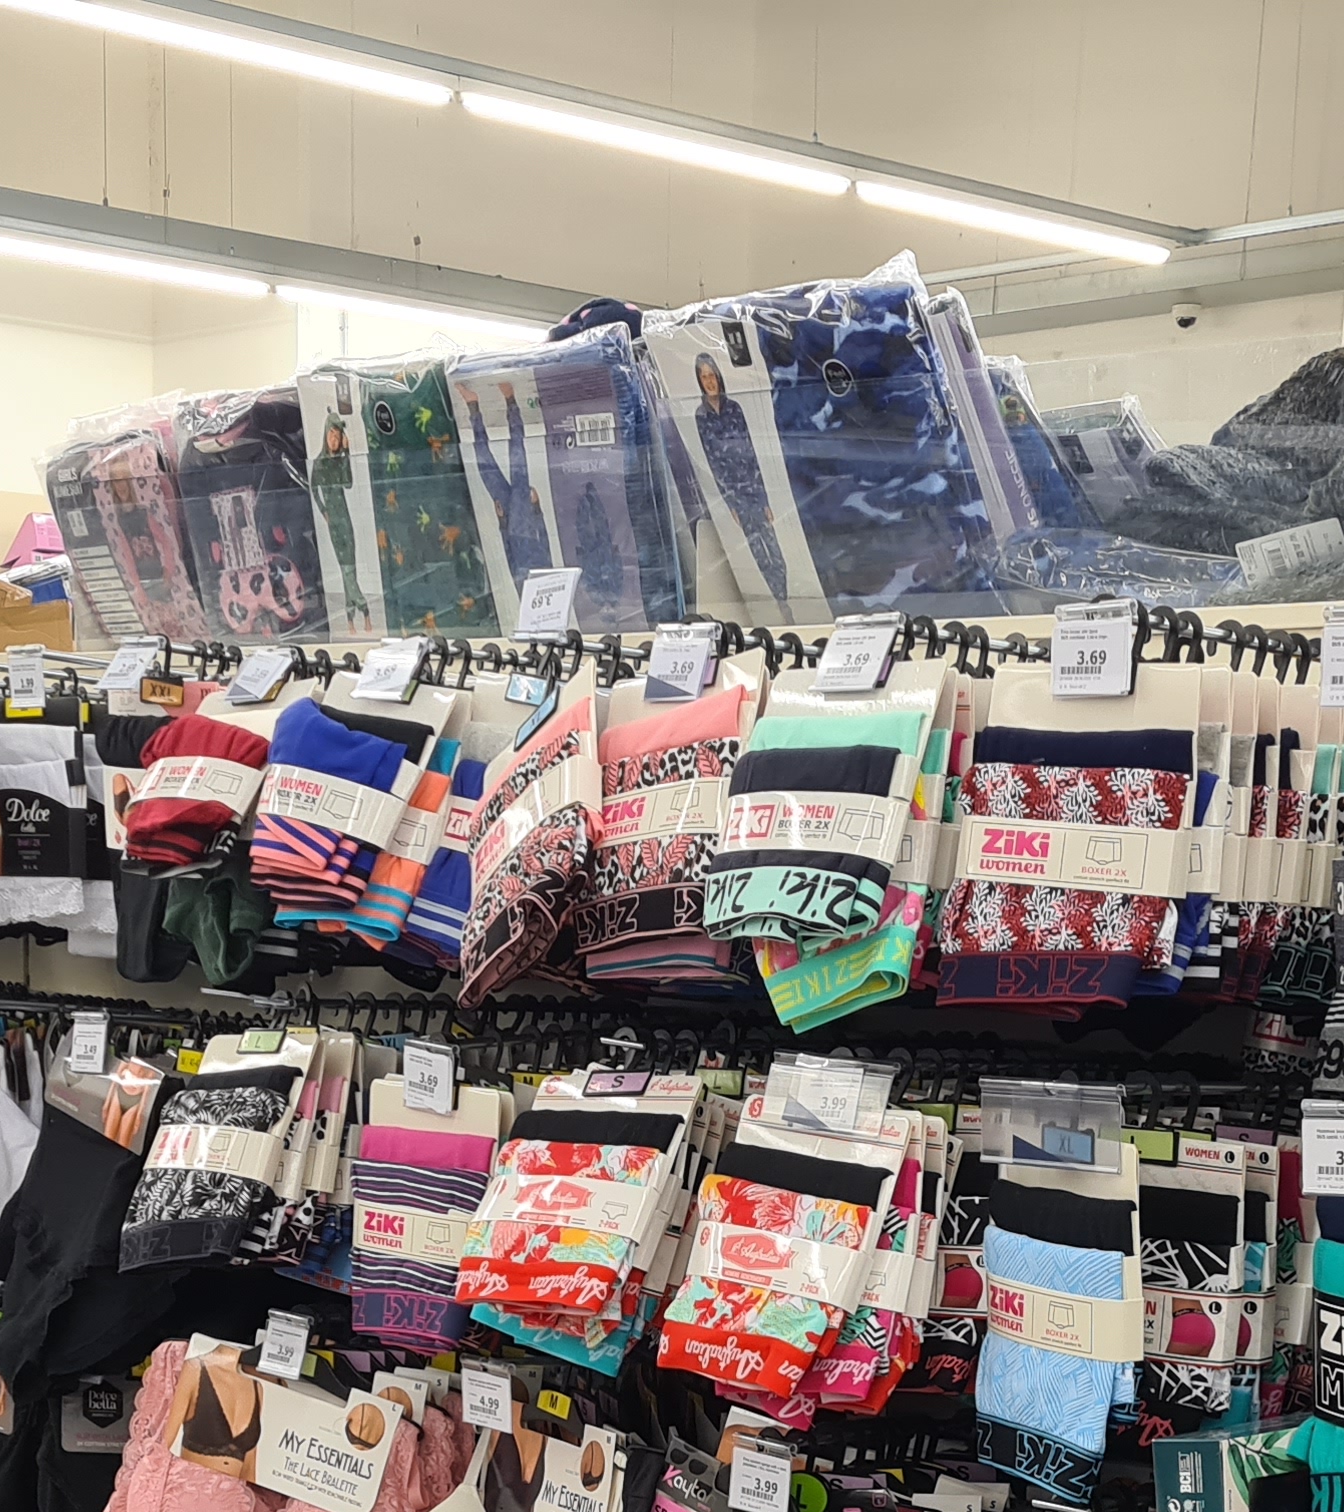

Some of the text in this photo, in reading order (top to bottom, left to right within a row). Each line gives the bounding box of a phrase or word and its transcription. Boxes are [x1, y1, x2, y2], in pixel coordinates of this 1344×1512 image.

[842, 652, 870, 667] 3.69
[1076, 649, 1107, 666] 3.69
[670, 661, 695, 675] 3.69
[280, 776, 325, 797] WOMEN
[6, 797, 50, 822] Dolce
[782, 803, 834, 820] WOMEN
[979, 857, 1046, 876] women
[418, 1071, 439, 1088] 3.69
[611, 1074, 625, 1089] S
[363, 1233, 402, 1249] women
[989, 1315, 1025, 1334] women
[88, 1389, 117, 1401] Dolce
[479, 1395, 500, 1410] 4.99
[548, 1394, 559, 1409] M
[88, 1400, 117, 1411] bella
[278, 1428, 374, 1480] MY ESSENTIALS
[300, 1462, 320, 1483] LACE
[320, 1466, 359, 1496] BRALETTE
[541, 1480, 558, 1504] MY
